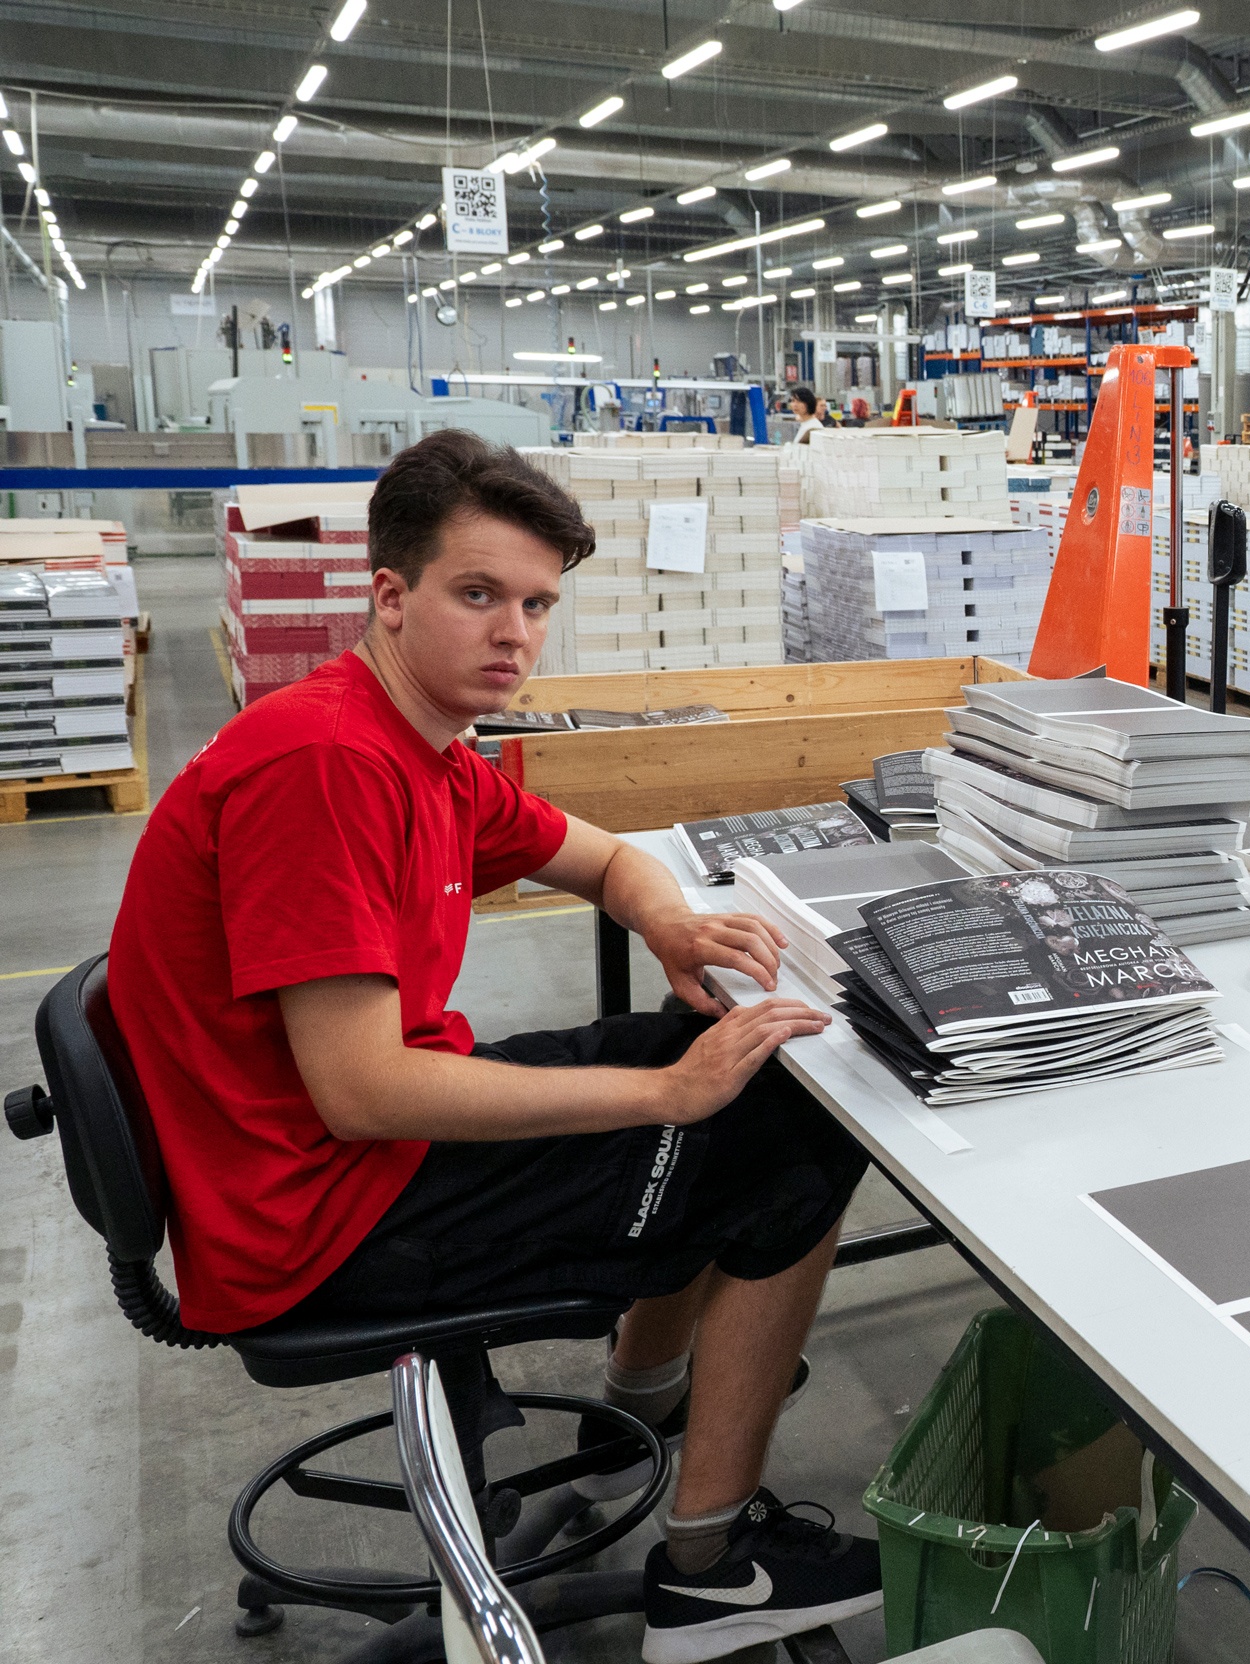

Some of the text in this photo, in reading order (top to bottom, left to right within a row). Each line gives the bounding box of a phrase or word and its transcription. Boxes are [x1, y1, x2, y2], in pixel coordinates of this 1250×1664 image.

[741, 837, 765, 857] MEGHA
[1064, 904, 1134, 922] ŻELAZNA
[1070, 921, 1152, 939] KSIĘŻNICZKA
[1073, 946, 1179, 966] MEGHAN
[1086, 963, 1195, 988] MARCH
[652, 1177, 669, 1215] ESTABLISHED
[628, 1181, 659, 1238] BLACK
